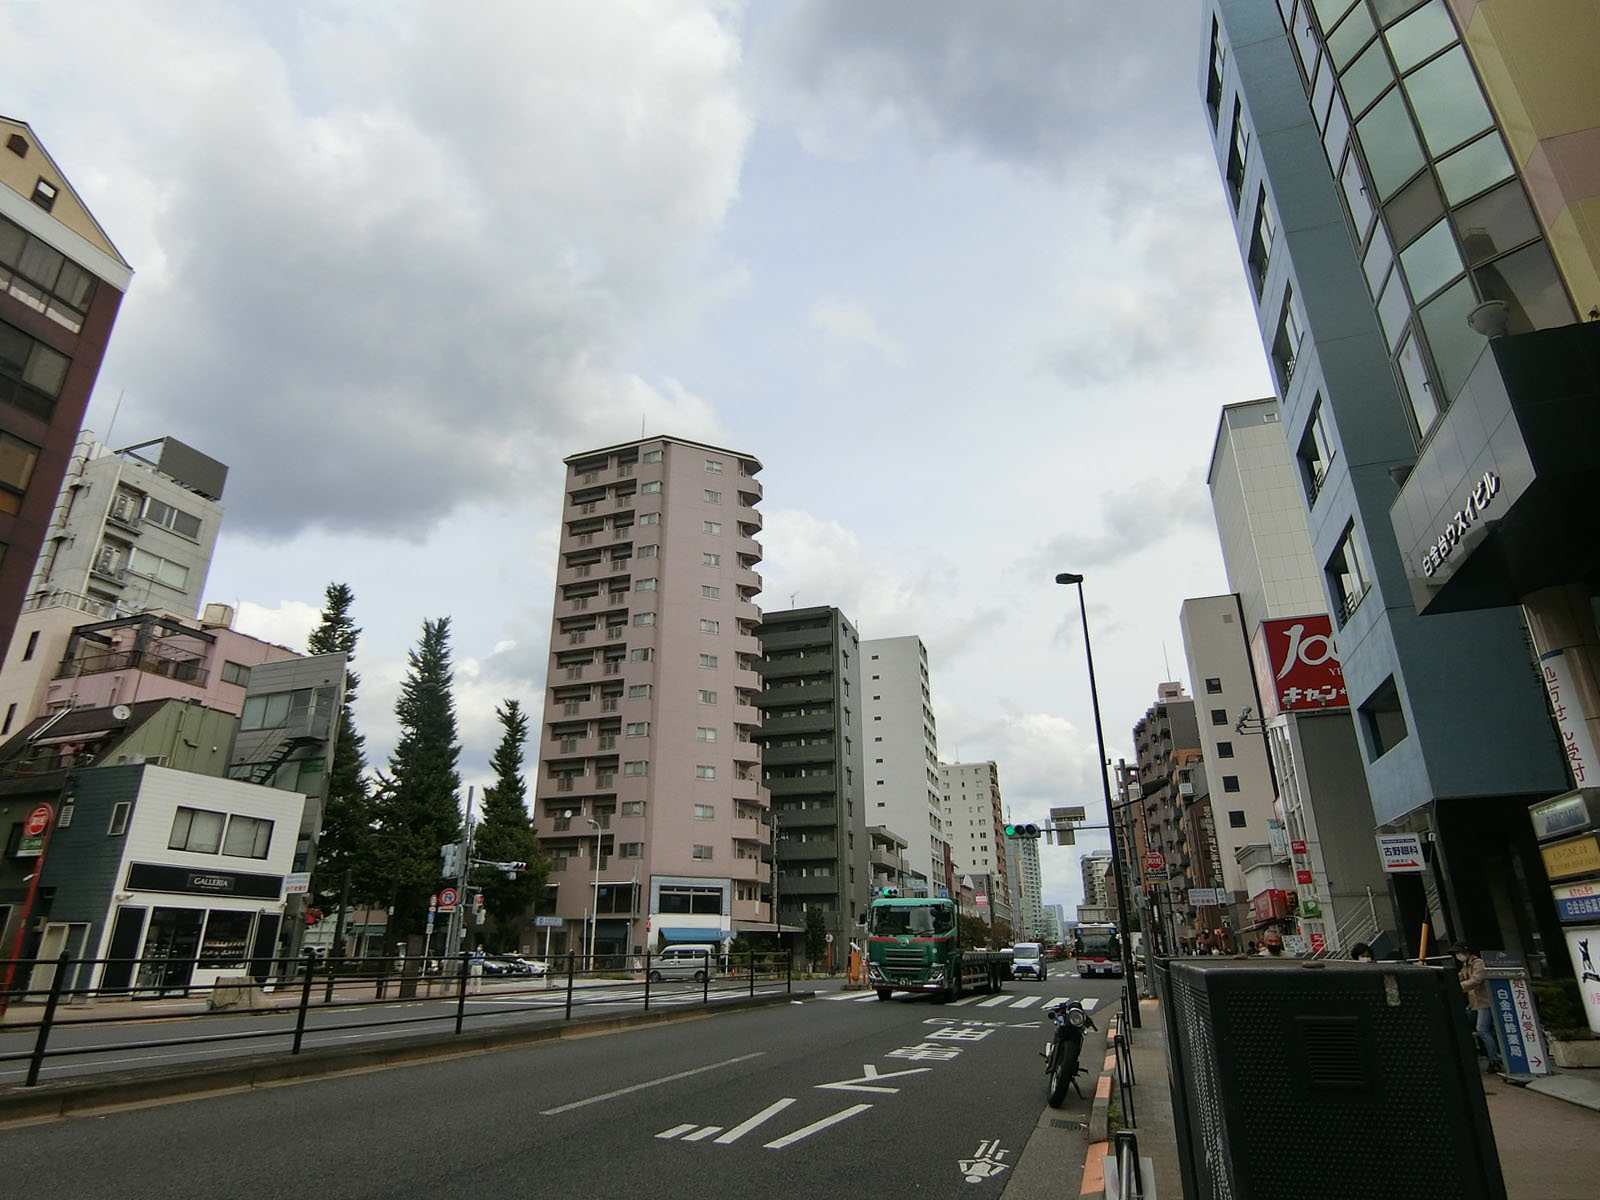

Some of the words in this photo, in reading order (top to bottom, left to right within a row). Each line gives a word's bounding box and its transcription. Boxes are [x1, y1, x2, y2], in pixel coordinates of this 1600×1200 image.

[1422, 471, 1500, 577] 白金台ウスイビル
[194, 877, 228, 887] GALLERIA
[1383, 845, 1419, 857] 古野眼科
[1496, 989, 1522, 1057] 白金台鈴薬局
[1512, 978, 1536, 1042] 処方せん受付
